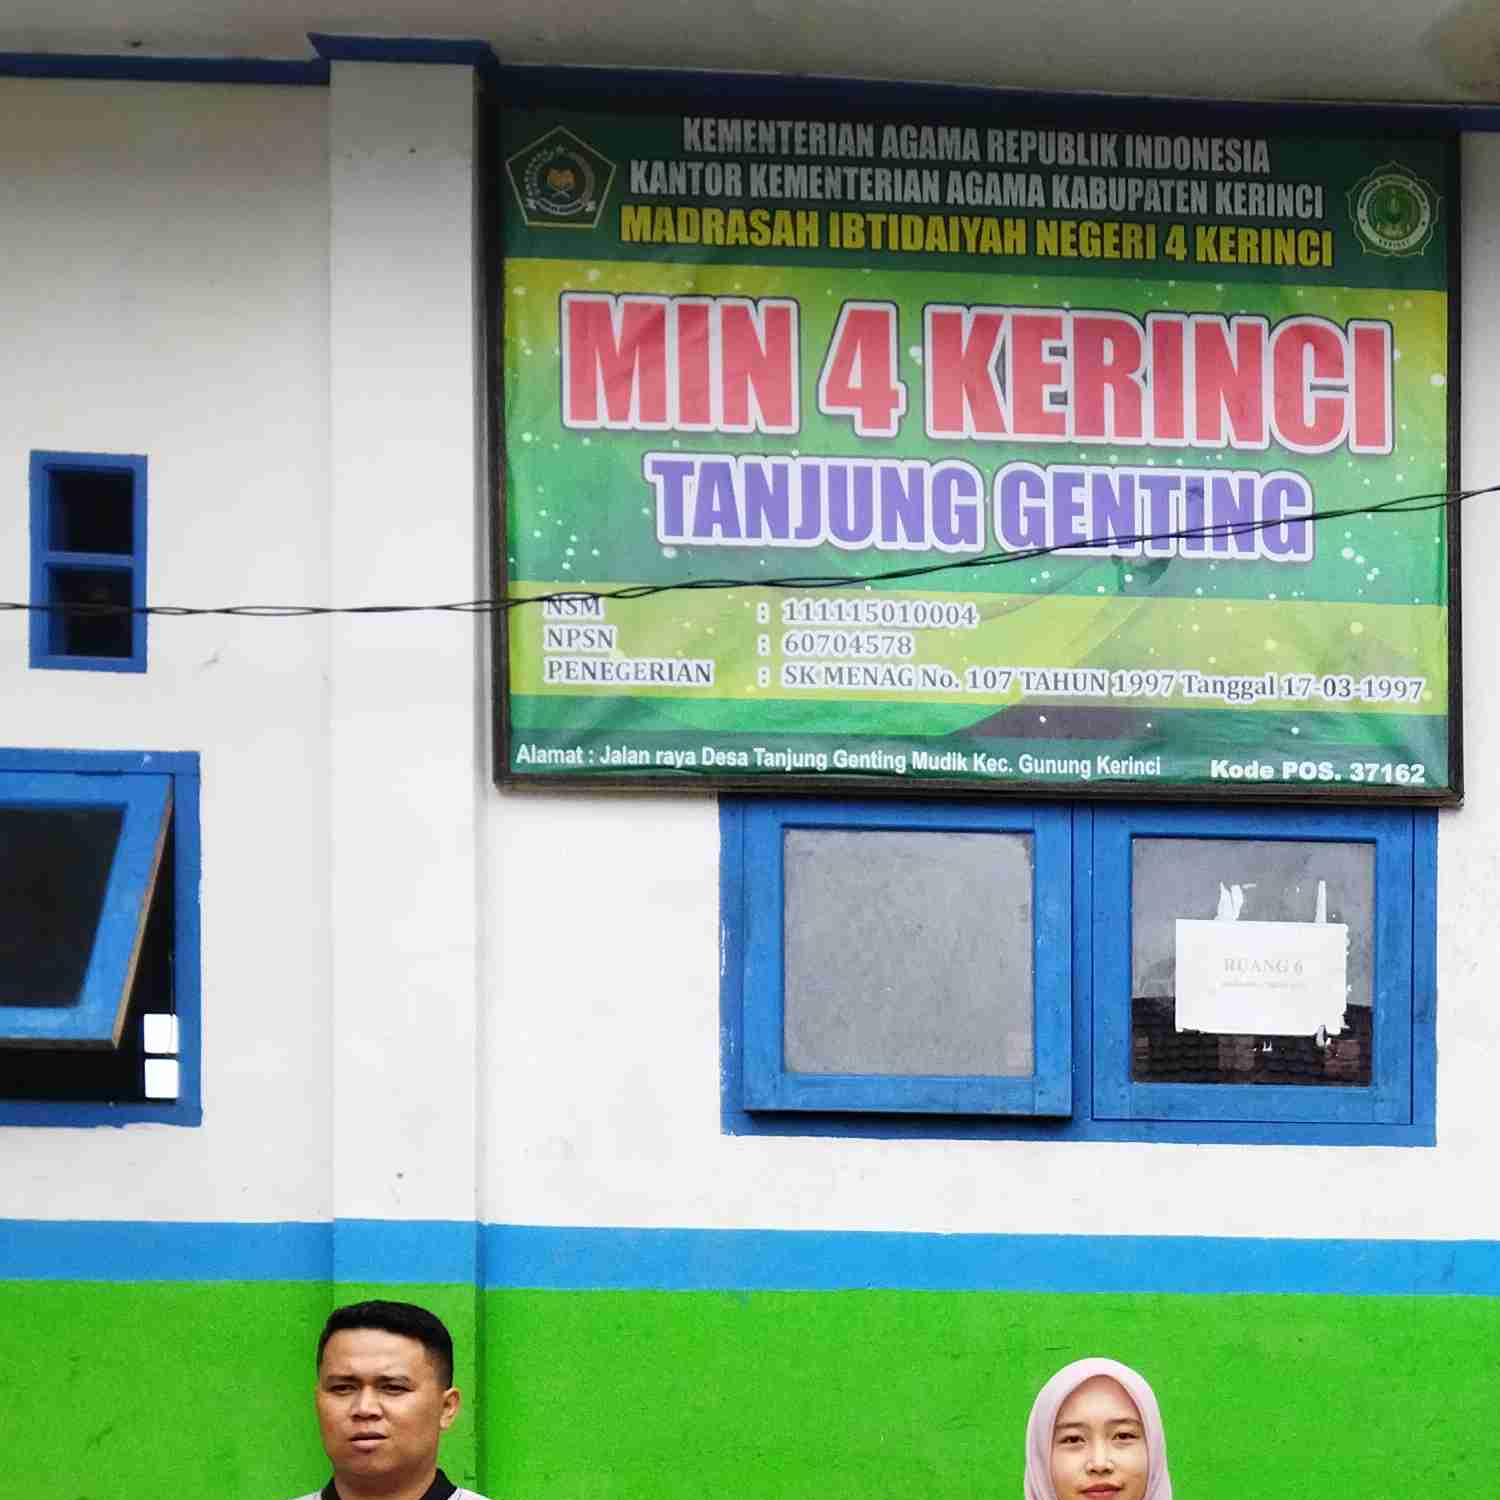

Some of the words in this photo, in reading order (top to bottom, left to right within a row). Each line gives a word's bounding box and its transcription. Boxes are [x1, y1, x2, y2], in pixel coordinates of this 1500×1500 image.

[684, 117, 874, 158] KEMENTERIAN
[881, 124, 980, 163] AGAMA
[987, 128, 1119, 168] REPUBLIK
[1125, 134, 1270, 174] INDONESIA
[630, 159, 743, 197] KANTOR
[750, 163, 941, 204] KEMENTERIAN
[946, 168, 1045, 209] AGAMA
[1052, 174, 1208, 215] KABUPATEN
[1215, 181, 1323, 219] KERINCI
[621, 205, 819, 248] MADRASAH
[829, 211, 1027, 256] IBTIDAIYAH
[1035, 218, 1156, 261] NEGERI
[1164, 223, 1187, 262] 4
[1196, 226, 1333, 267] KERINCI
[564, 297, 796, 429] MIN
[821, 304, 904, 432] 4
[928, 308, 1391, 450] KERINCI
[649, 456, 984, 547] TANJUNG
[996, 464, 1310, 557] GENTING
[546, 598, 601, 616] NSM
[783, 601, 977, 625] 111115010004
[547, 628, 614, 649] NPSN
[783, 633, 913, 656] 60704578
[547, 660, 713, 683] PENEGERIAN
[783, 665, 815, 686] SK
[823, 666, 914, 687] MENAG
[921, 668, 960, 689] No.
[968, 670, 1012, 690] 107
[1022, 671, 1106, 692] TAHUN
[1114, 673, 1175, 694] 1997
[1181, 674, 1276, 700] Tanggal
[1284, 676, 1424, 700] 17-03-1997
[515, 744, 585, 765] Alamat
[599, 745, 651, 766] Jalan
[656, 750, 696, 769] raya
[701, 747, 749, 767] Desa
[753, 747, 828, 771] Tanjung
[833, 749, 906, 773] Genting
[912, 750, 967, 771] Mudik
[973, 753, 1013, 774] Kec.
[1018, 754, 1091, 778] Gunung
[1096, 754, 1161, 776] Kerinci
[1210, 759, 1275, 779] Kode
[1281, 760, 1341, 781] POS.
[1350, 763, 1425, 784] 37162
